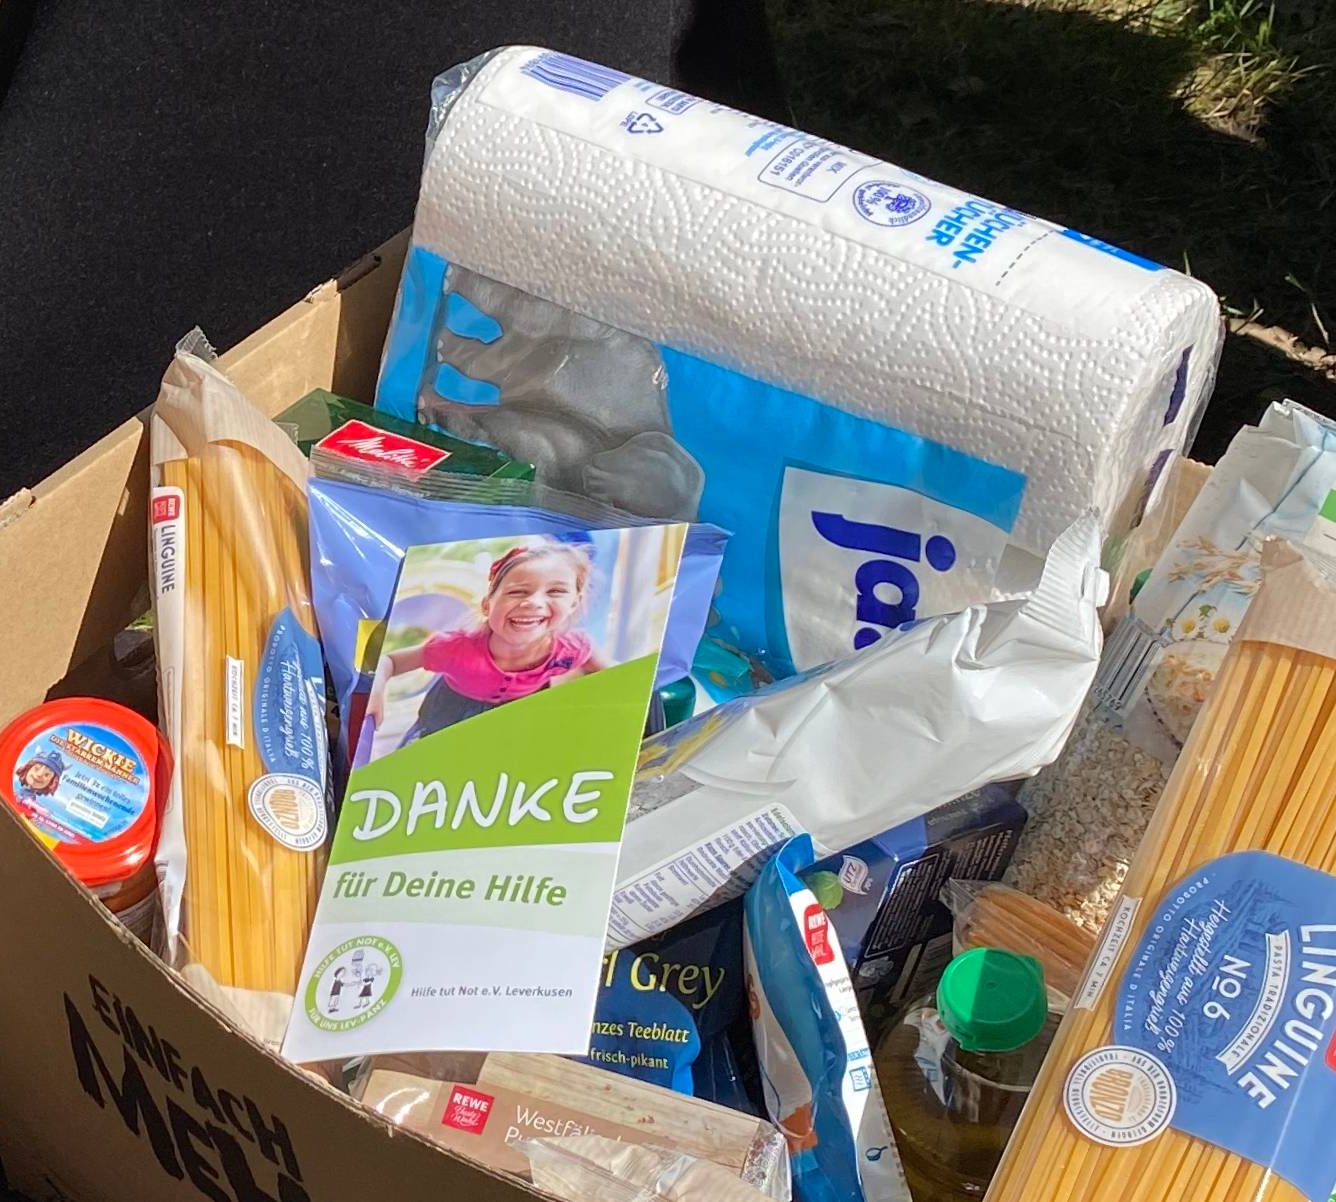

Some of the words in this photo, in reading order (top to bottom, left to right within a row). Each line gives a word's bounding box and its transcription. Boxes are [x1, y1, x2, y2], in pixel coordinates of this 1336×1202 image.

[160, 525, 175, 594] LINGUINE
[66, 728, 137, 773] WICKIE
[269, 789, 300, 830] BRONZO
[349, 770, 615, 842] DANKE
[333, 871, 378, 899] für
[383, 871, 475, 900] Deine
[484, 874, 568, 906] Hilfe
[843, 863, 856, 885] UTZ
[1164, 876, 1210, 922] PRODOTTO
[336, 940, 355, 957] TUT
[356, 936, 377, 948] NOT
[1110, 906, 1131, 954] KOCHZEIT
[1137, 925, 1165, 979] ORIGINALE
[1187, 898, 1233, 978] Hergestellt
[630, 952, 726, 1010] Grey
[1144, 916, 1198, 1032] Hartweizengrieß
[1270, 945, 1283, 979] PASTA
[411, 986, 437, 998] Hilfe
[439, 986, 456, 998] tut
[457, 986, 479, 997] Not
[481, 986, 502, 997] e.V.
[505, 985, 574, 998] Leverkusen
[1087, 979, 1100, 998] MIN
[1177, 979, 1195, 1007] aus
[591, 1022, 624, 1037] nzes
[628, 1021, 691, 1043] Teeblatt
[1233, 982, 1279, 1060] TRADIZIONALE
[1237, 923, 1336, 1109] LINGUINE
[88, 973, 304, 1183] EINFACH
[590, 1049, 670, 1070] frisch-pikant
[452, 1091, 489, 1112] REWE
[1089, 1068, 1134, 1122] BRONZO
